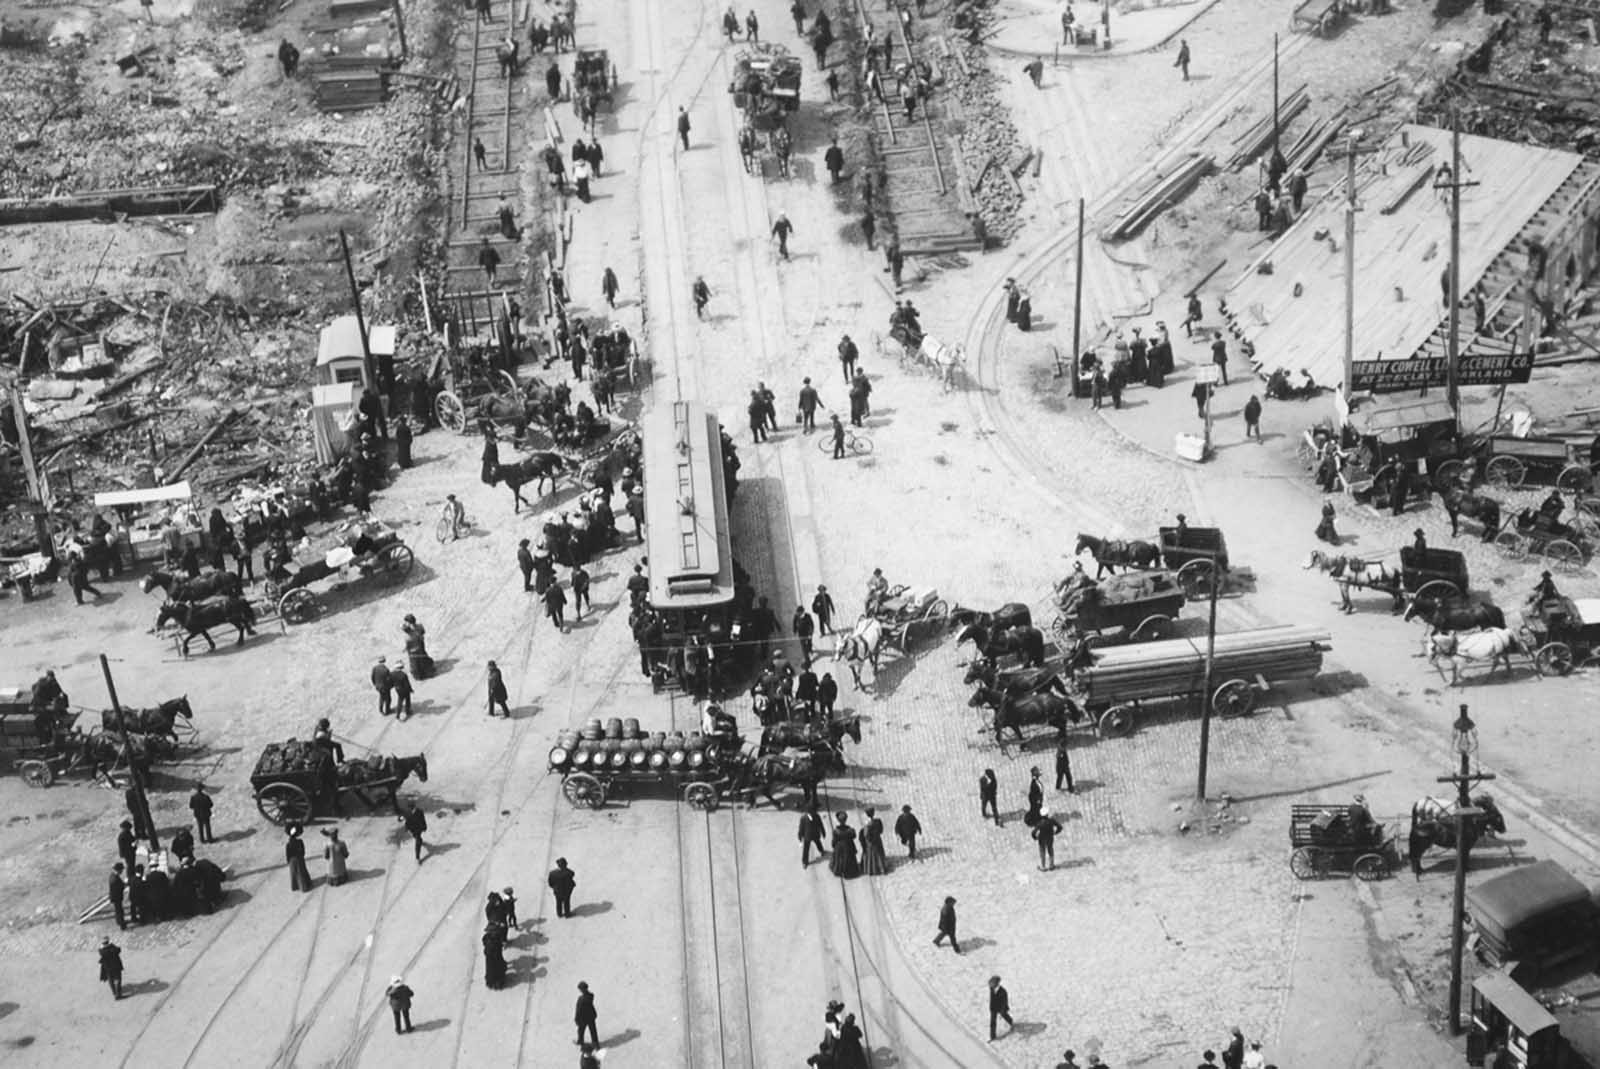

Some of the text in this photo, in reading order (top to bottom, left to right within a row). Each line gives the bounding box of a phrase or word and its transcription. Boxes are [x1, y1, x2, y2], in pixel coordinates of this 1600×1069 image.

[1352, 362, 1390, 375] HENRY
[1391, 359, 1431, 373] COWELL
[1468, 356, 1510, 369] CEMENT
[1511, 355, 1530, 369] CO.
[1358, 375, 1376, 385] AT
[1402, 371, 1433, 381] CLAY
[1457, 368, 1512, 379] AKLAND
